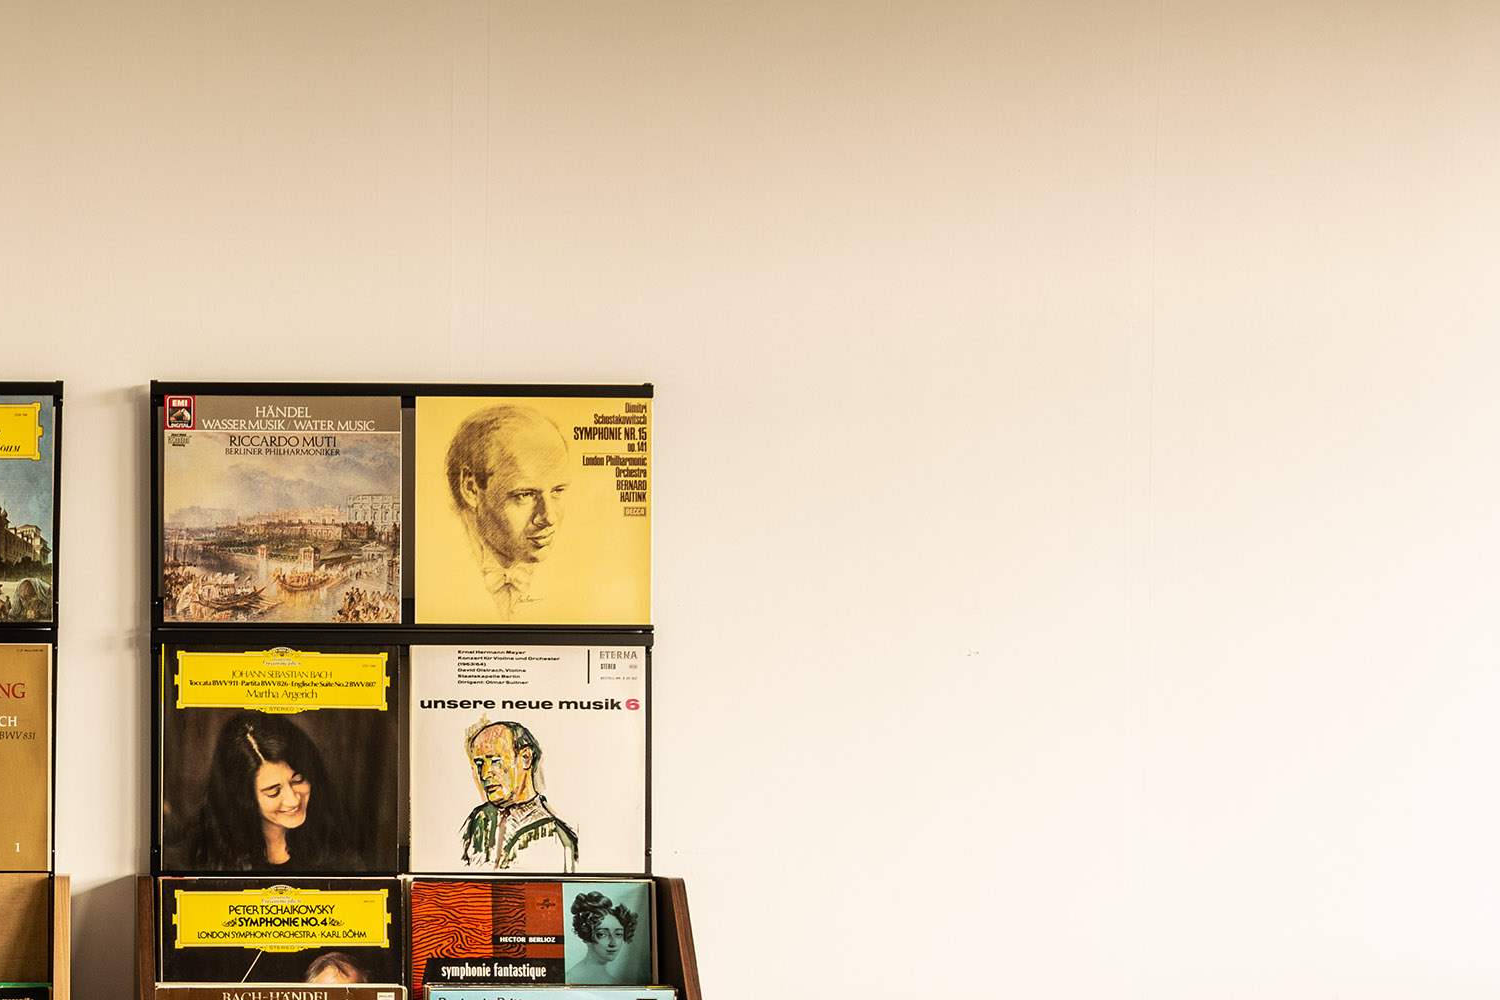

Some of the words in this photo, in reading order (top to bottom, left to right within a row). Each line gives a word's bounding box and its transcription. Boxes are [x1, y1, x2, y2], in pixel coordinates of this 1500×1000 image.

[256, 406, 311, 417] HÄNDEL
[202, 420, 285, 430] WASSERMUSIK
[293, 420, 334, 430] WATER
[338, 421, 375, 430] MUSIC
[574, 427, 622, 440] SYMPHONIE
[230, 436, 299, 447] RICCARDO
[303, 437, 336, 447] MUTI
[617, 480, 647, 490] BERNARD
[620, 492, 646, 502] HAITINK
[600, 651, 638, 659] ETERNA
[247, 689, 279, 699] Martha
[281, 690, 317, 699] Argerich
[420, 699, 495, 709] unsere
[502, 700, 553, 709] neue
[558, 699, 622, 710] musik
[625, 699, 639, 710] 6
[229, 905, 260, 914] PETER
[261, 905, 335, 914] TSCHAIKOWSKY
[238, 917, 299, 927] SYMPHONIE
[442, 962, 491, 980] symphonie
[494, 963, 546, 980] fantastique
